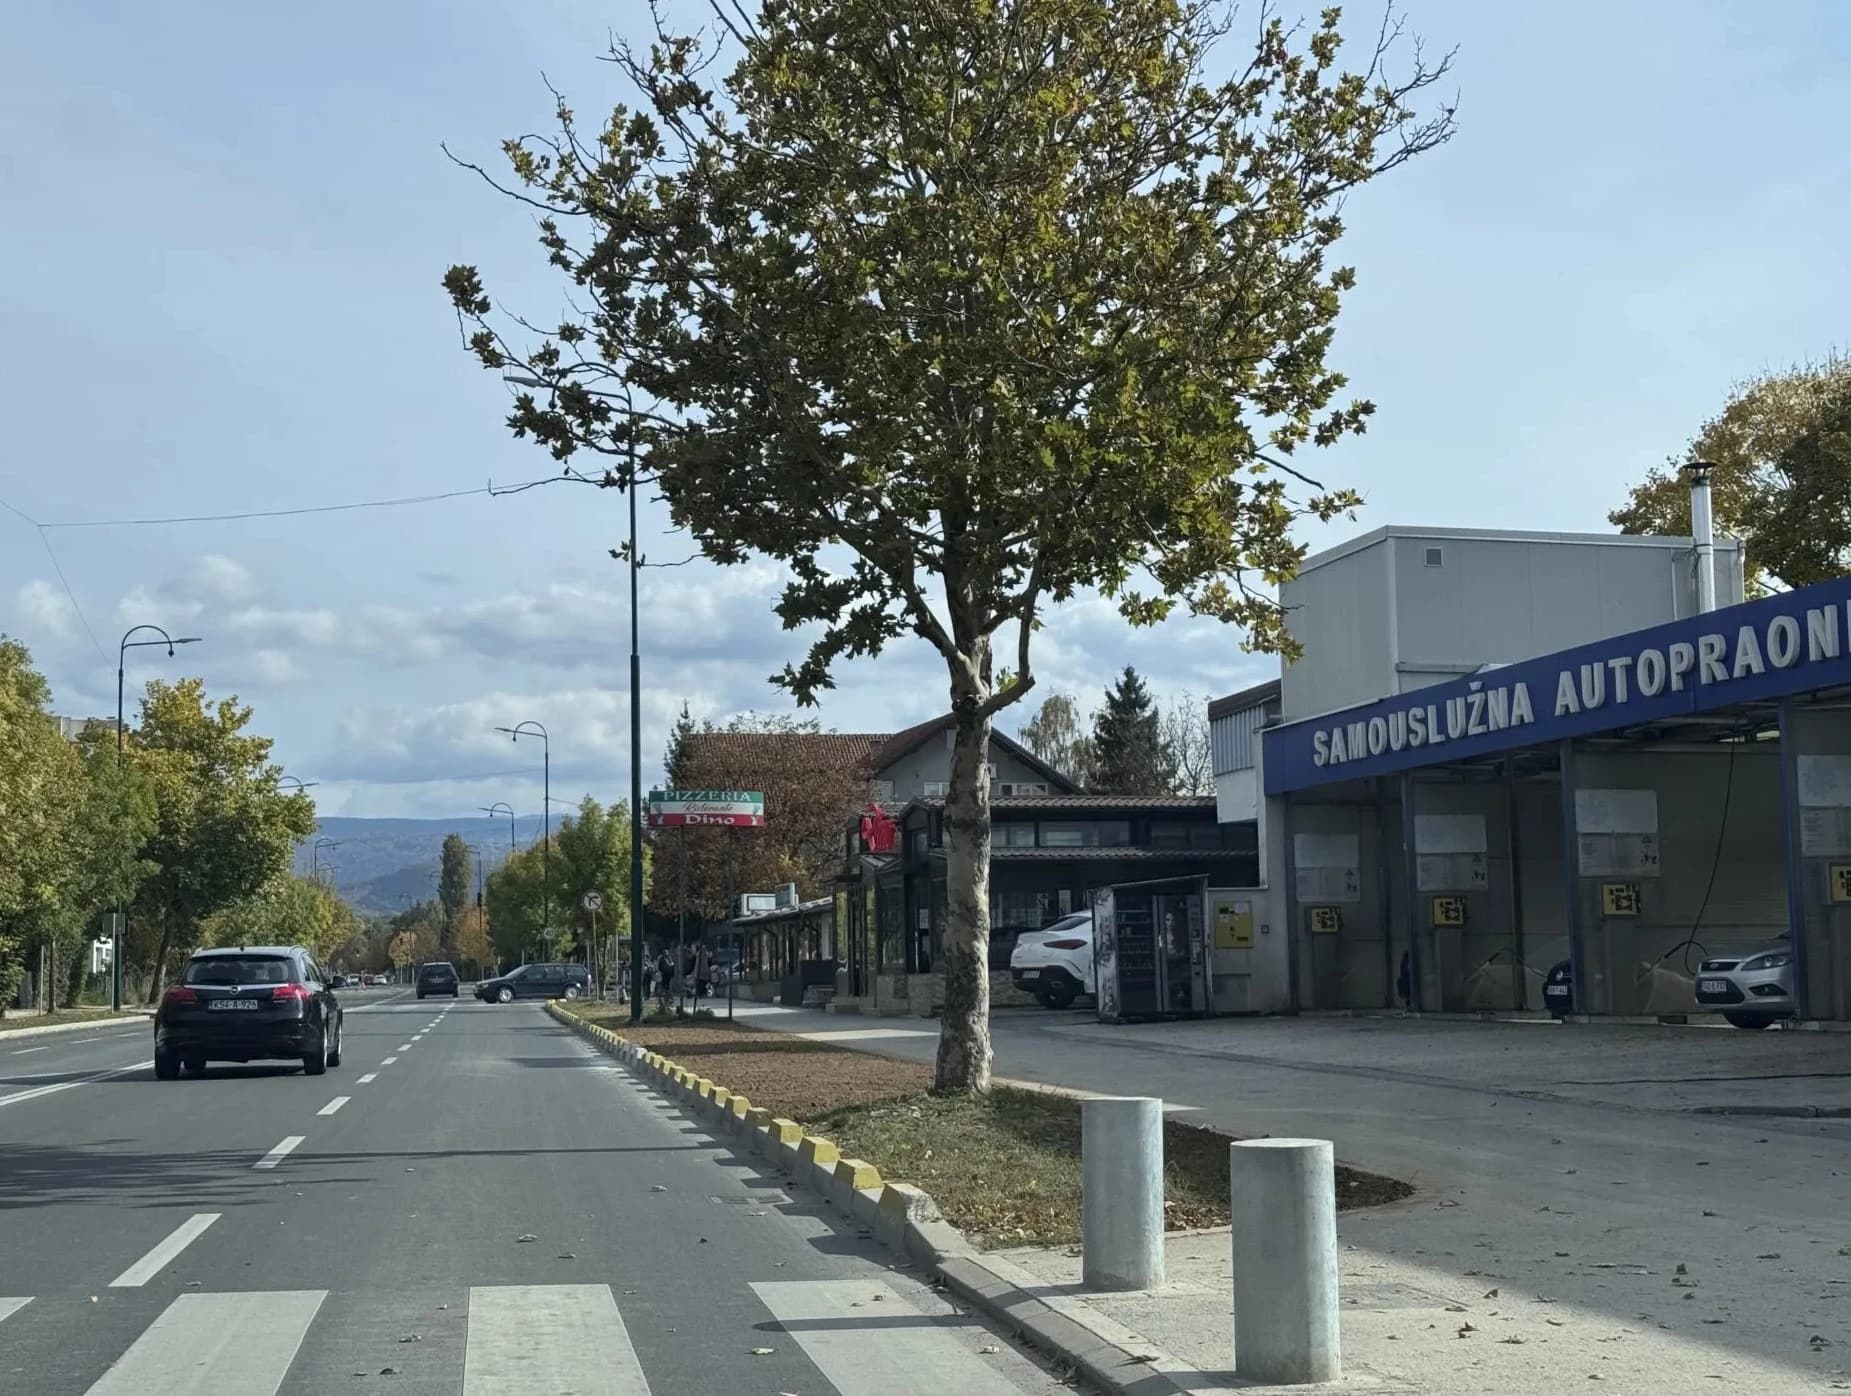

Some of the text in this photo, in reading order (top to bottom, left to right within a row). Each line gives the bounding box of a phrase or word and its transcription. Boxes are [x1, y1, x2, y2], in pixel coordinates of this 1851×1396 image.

[1313, 681, 1535, 768] SAMOUSLUŽNA
[663, 791, 752, 801] PIZZERIA
[684, 814, 736, 825] Dino
